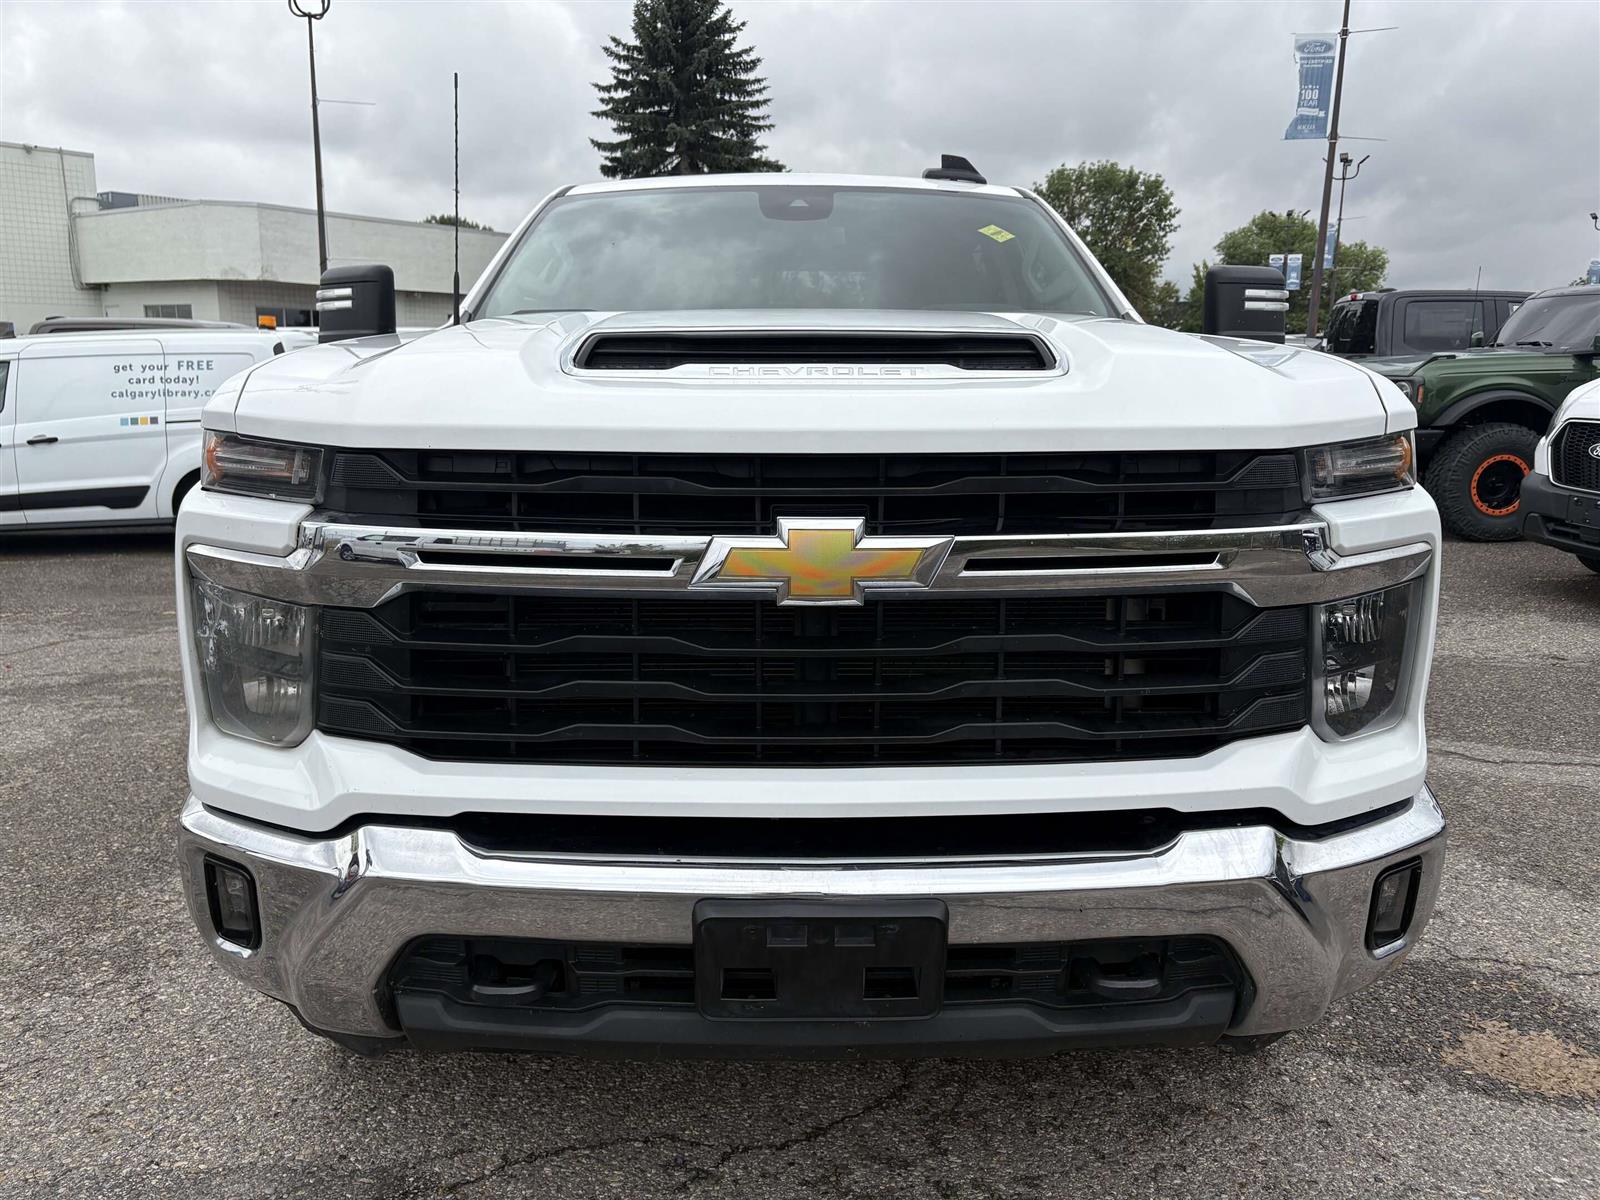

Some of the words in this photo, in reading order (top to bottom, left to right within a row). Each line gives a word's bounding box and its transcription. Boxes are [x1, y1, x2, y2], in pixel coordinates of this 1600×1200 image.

[1301, 89, 1319, 100] 100
[1299, 99, 1318, 107] YEAR
[113, 363, 134, 373] get
[140, 363, 169, 373] your
[177, 360, 214, 371] FREE
[708, 366, 925, 376] CHEVROLET
[128, 375, 155, 385] card
[160, 375, 199, 386] today!
